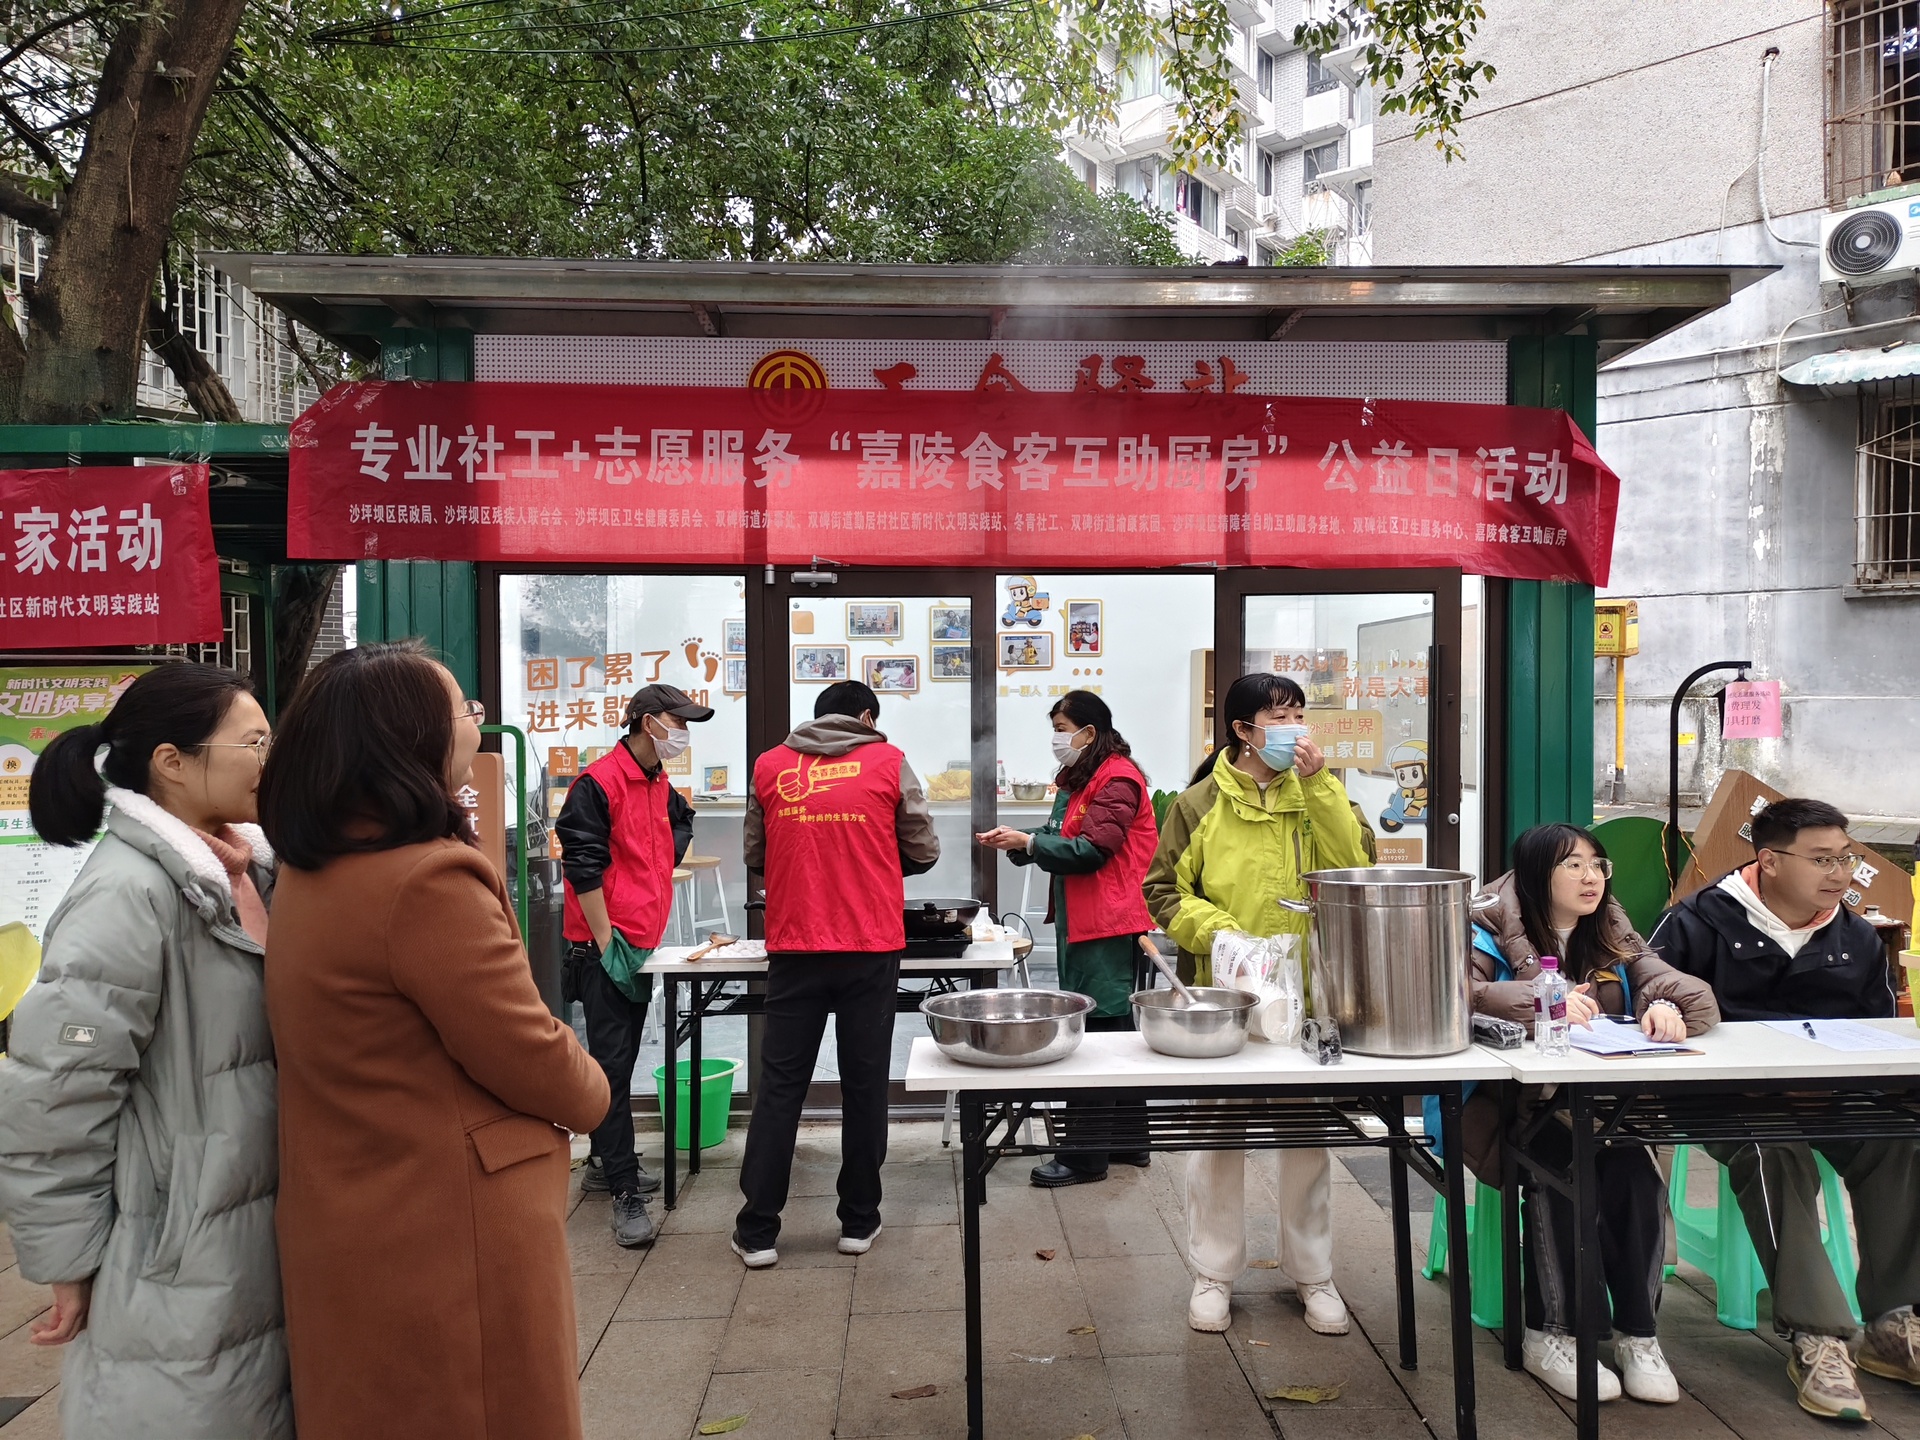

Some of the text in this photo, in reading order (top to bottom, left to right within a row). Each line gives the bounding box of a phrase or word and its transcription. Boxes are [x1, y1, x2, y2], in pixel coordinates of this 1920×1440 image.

[0, 502, 163, 576] 家活动
[527, 650, 671, 691] 困了累了
[6, 677, 109, 690] 新时代文明实践
[1342, 675, 1428, 698] 就是大事
[1727, 700, 1761, 712] 费理发
